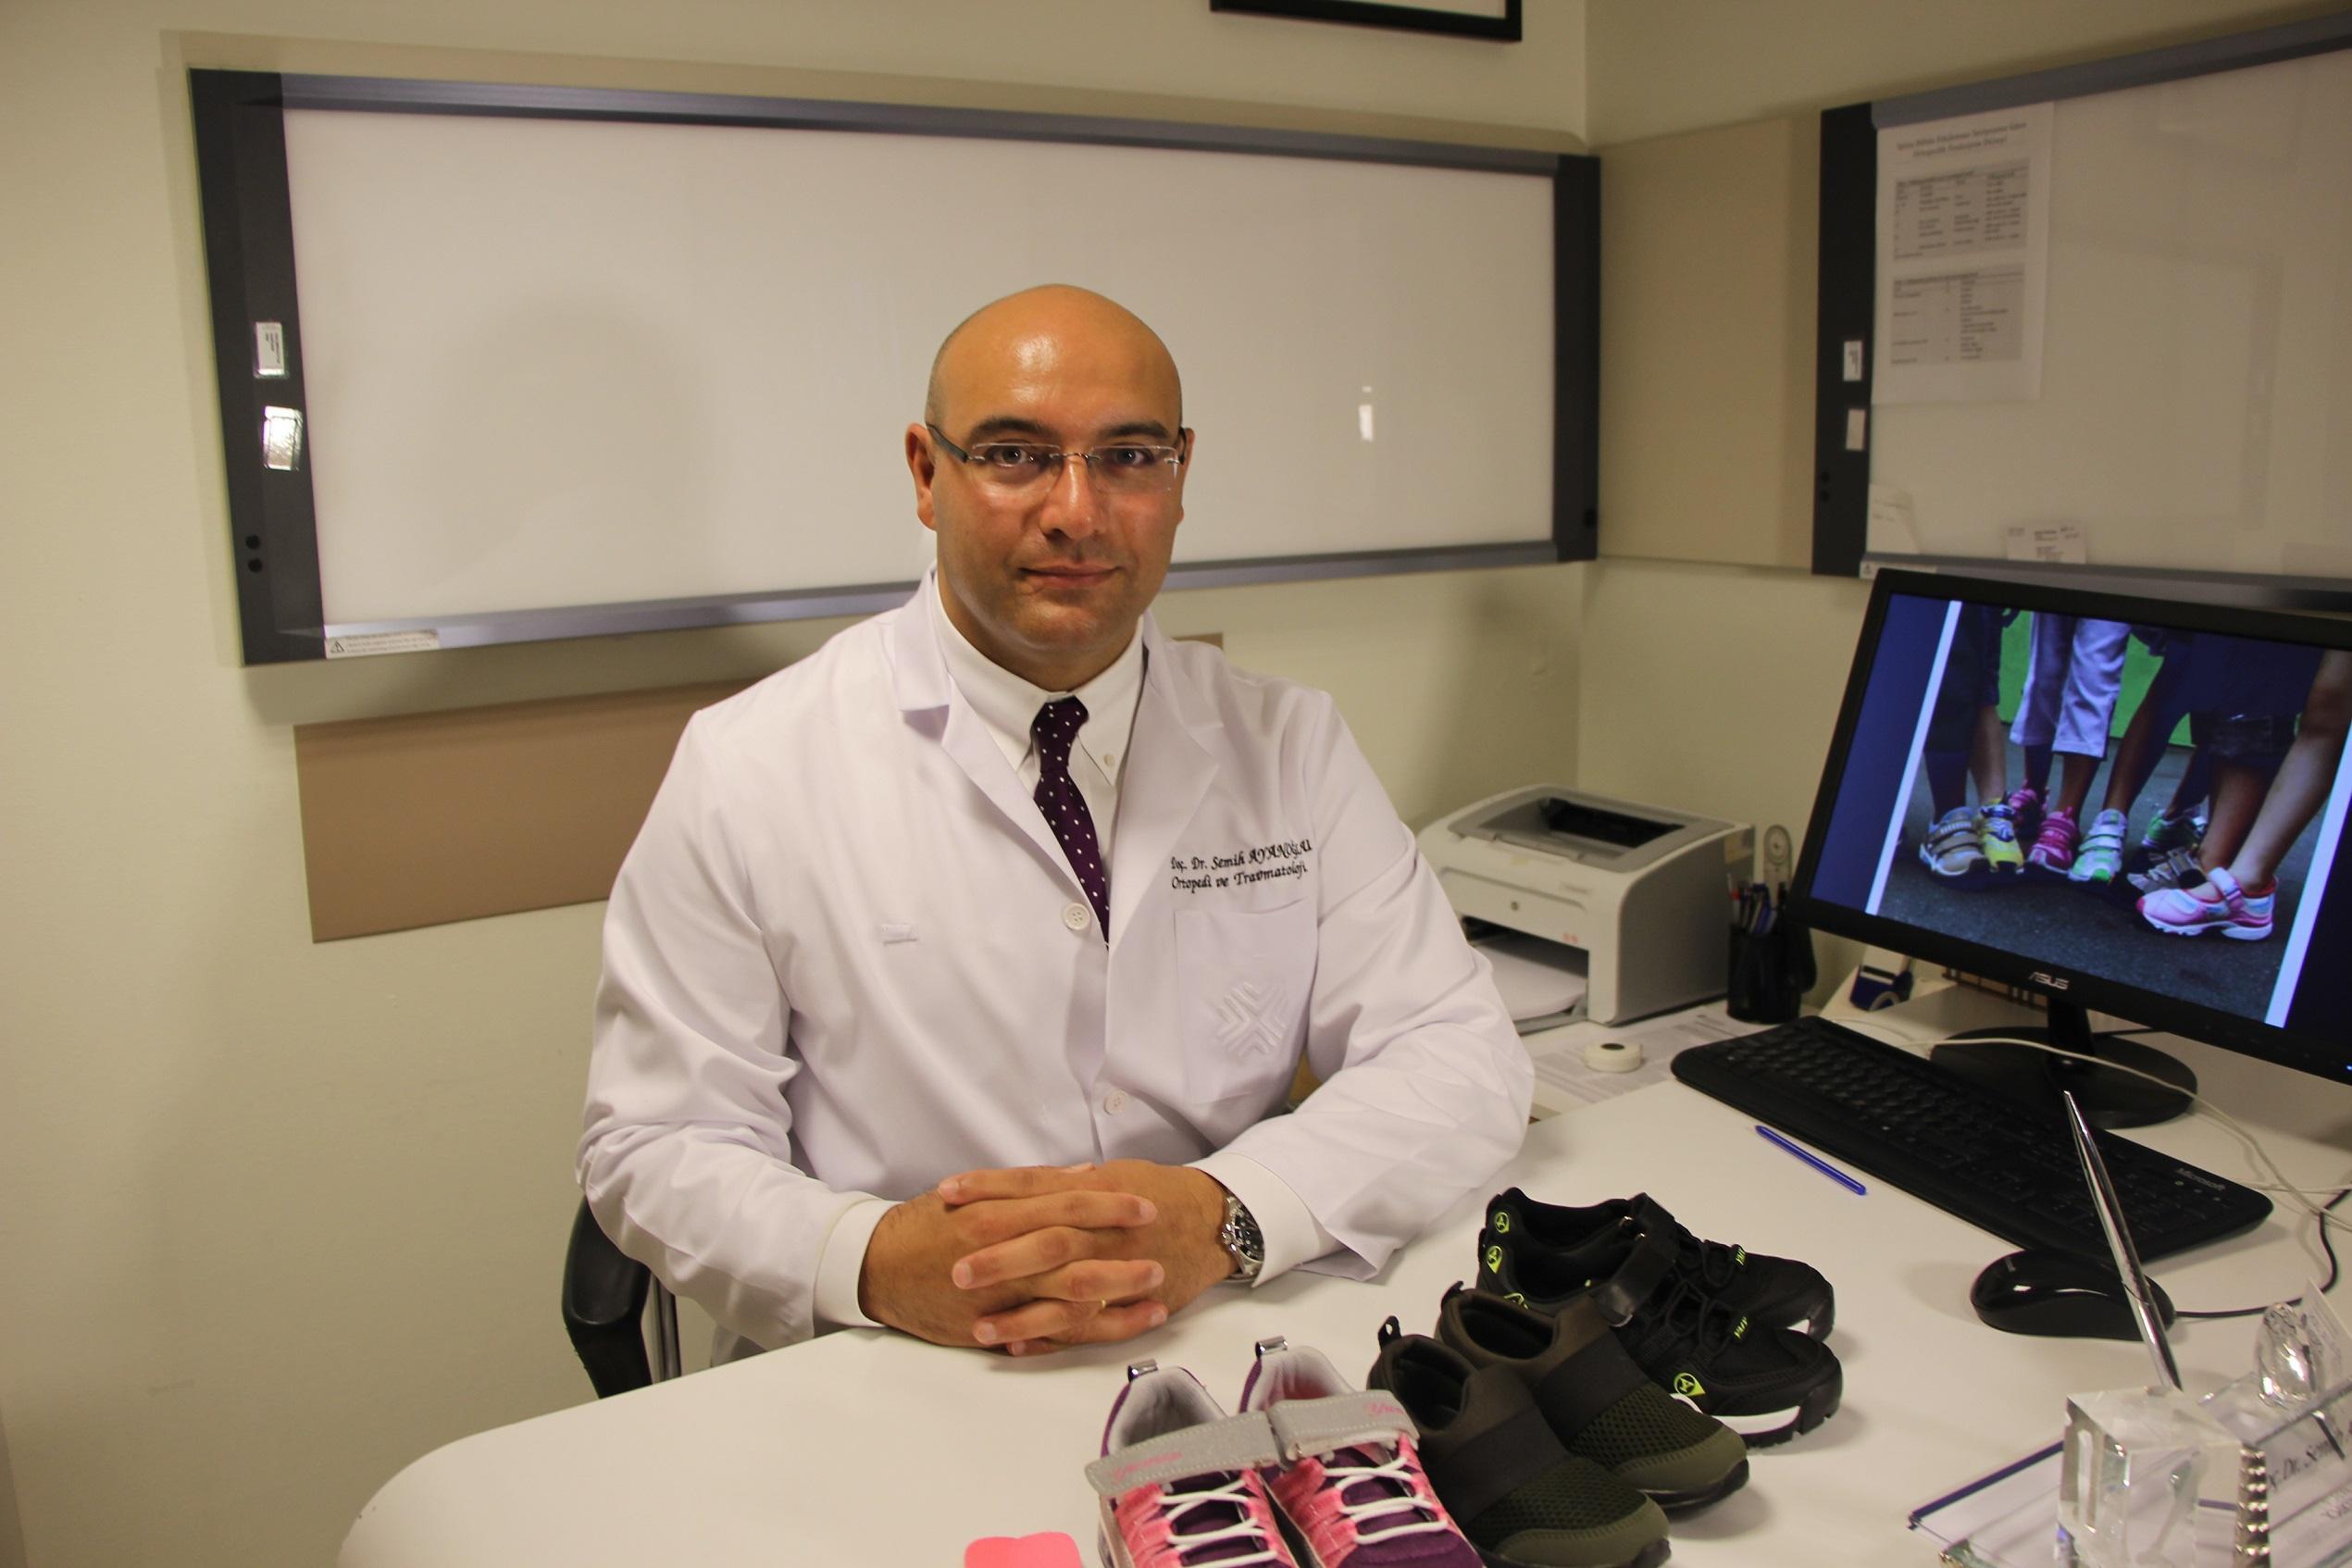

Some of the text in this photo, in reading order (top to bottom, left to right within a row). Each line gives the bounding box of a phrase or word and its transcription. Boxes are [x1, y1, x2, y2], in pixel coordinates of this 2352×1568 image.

[1190, 856, 1208, 870] Dr.
[1211, 851, 1245, 870] Semih
[1215, 877, 1229, 888] ve
[2028, 971, 2070, 990] ASUS
